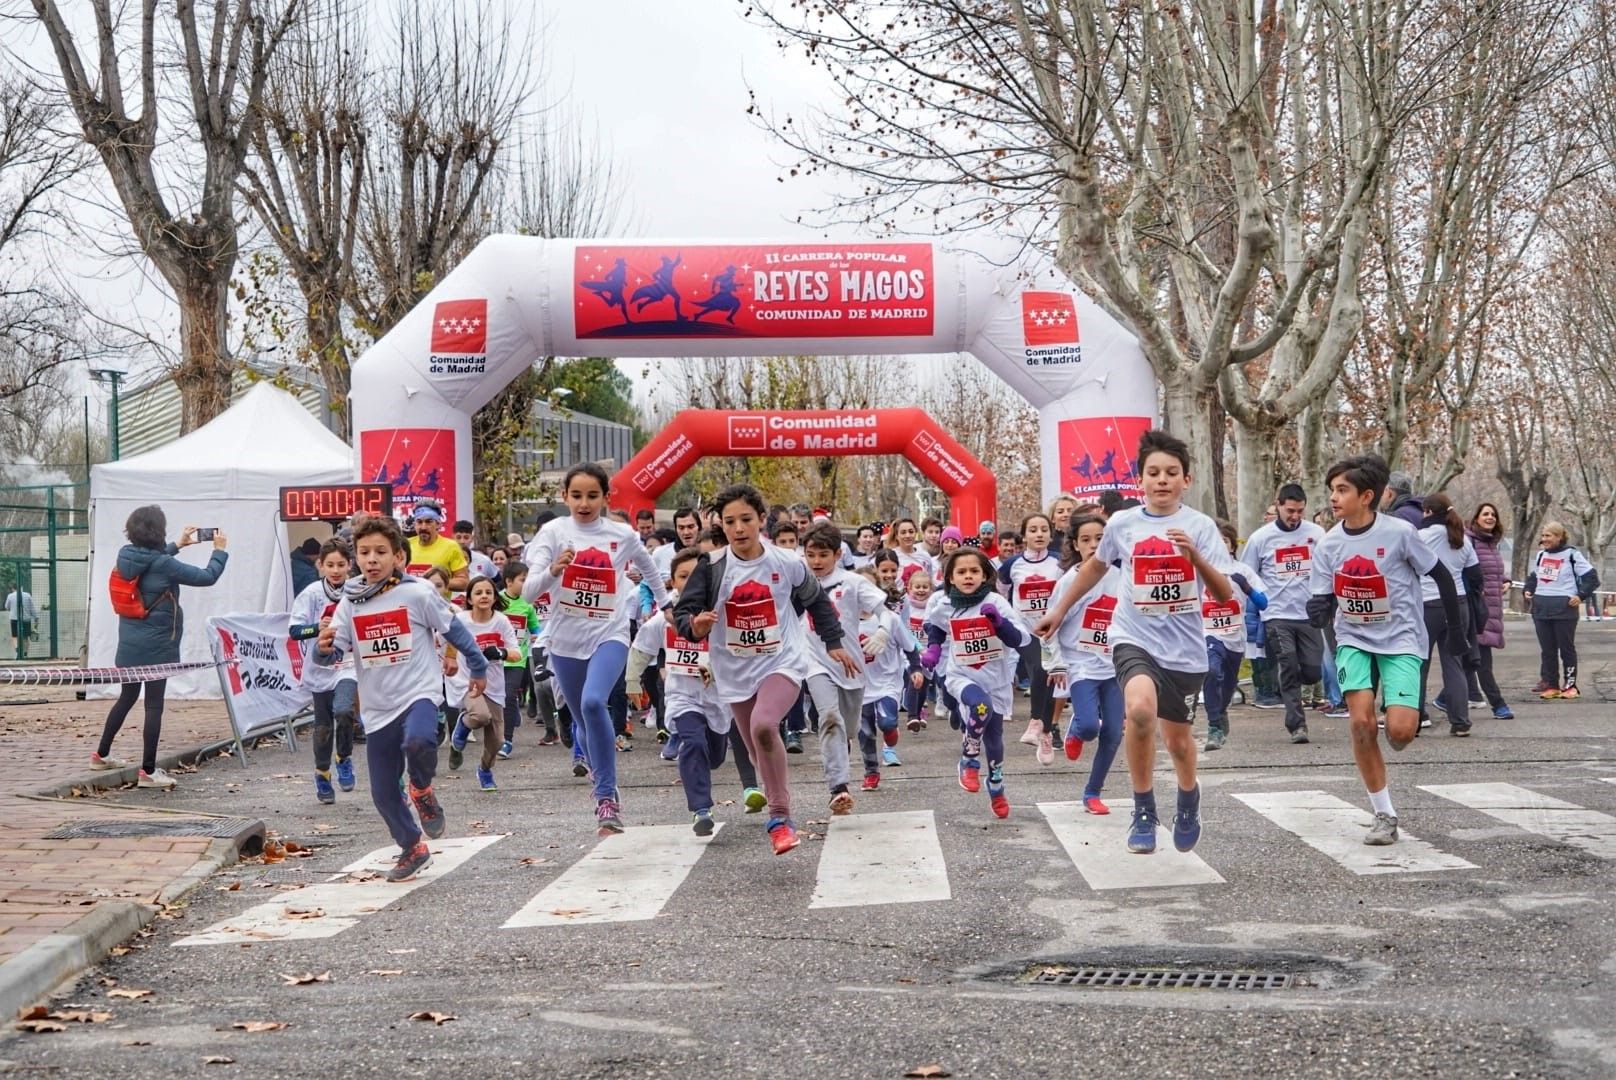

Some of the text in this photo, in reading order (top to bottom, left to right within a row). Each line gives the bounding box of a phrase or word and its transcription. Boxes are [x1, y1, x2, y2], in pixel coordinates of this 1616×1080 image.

[766, 252, 906, 264] II CARRERA POPULAR
[754, 269, 925, 302] REYES MAGOS
[756, 308, 928, 320] COMUNIDAD DE MADRID
[430, 355, 486, 364] Comunidad
[1025, 346, 1082, 357] Comunidad
[1026, 354, 1082, 366] de Madrid
[430, 364, 485, 373] de Madrid
[769, 414, 877, 430] Comunidad
[770, 432, 878, 450] de Madrid
[646, 433, 687, 471] Comunidad
[654, 440, 694, 478] de Madrid
[926, 450, 968, 487] de Madrid
[934, 443, 974, 480] Comunidad
[1074, 486, 1082, 494] II
[1083, 484, 1116, 492] CARRERA
[287, 488, 384, 516] 00:00:02
[1286, 562, 1301, 570] 687
[574, 591, 600, 608] 351
[1150, 584, 1180, 601] 483
[1030, 598, 1048, 610] 517
[1347, 600, 1373, 612] 350
[1213, 617, 1231, 627] 314
[740, 629, 766, 645] 484
[372, 637, 400, 654] 445
[964, 638, 989, 654] 689
[677, 650, 699, 665] 752
